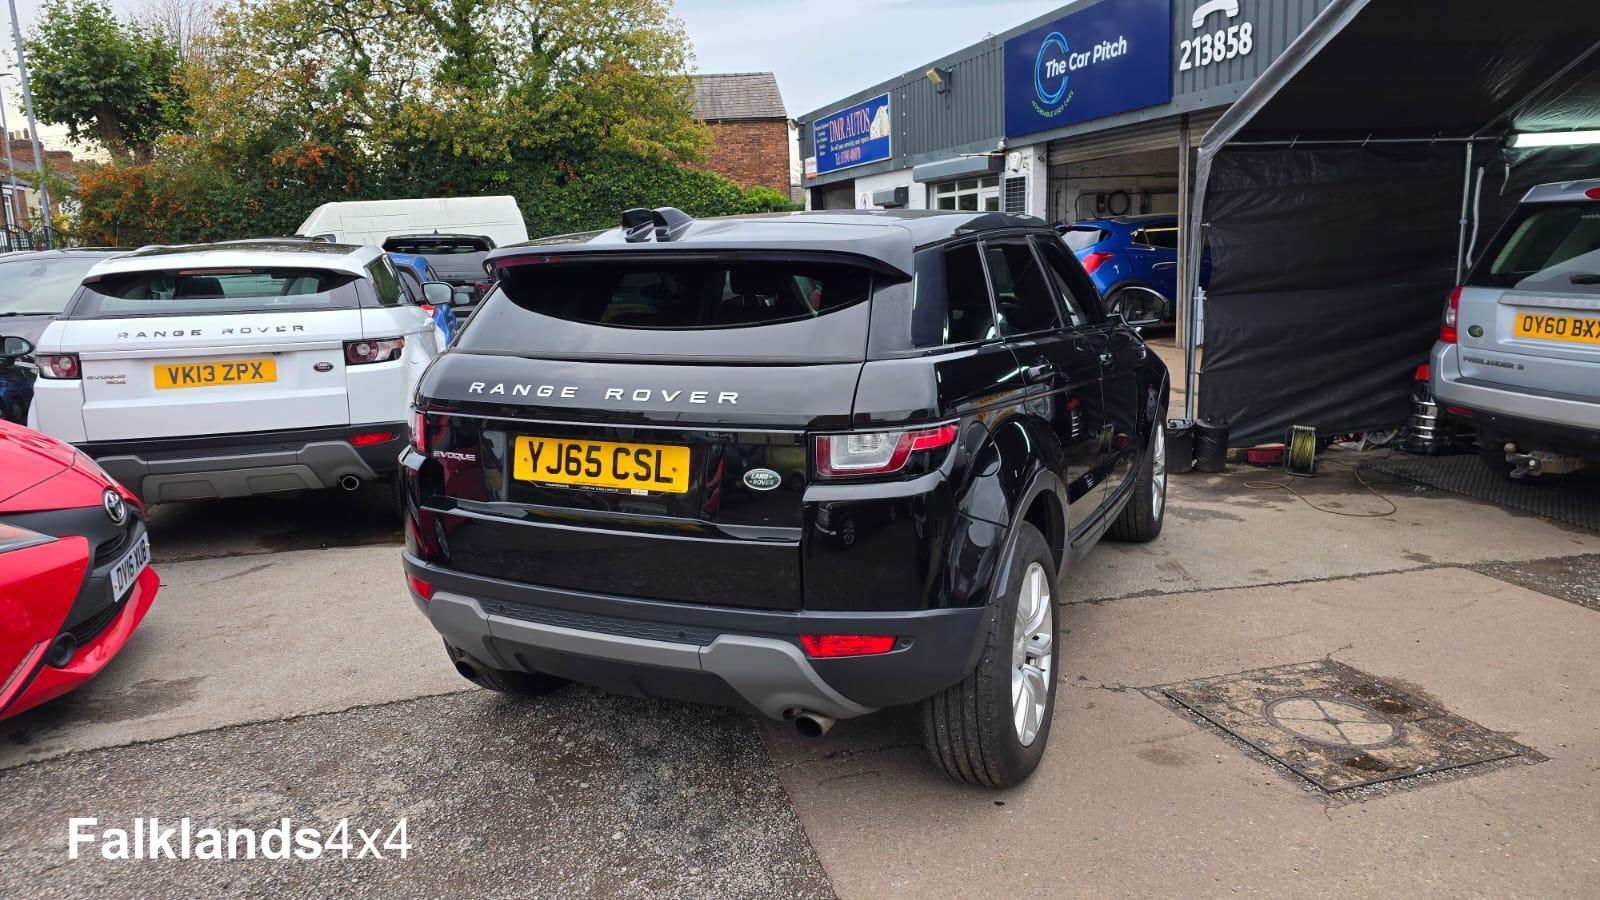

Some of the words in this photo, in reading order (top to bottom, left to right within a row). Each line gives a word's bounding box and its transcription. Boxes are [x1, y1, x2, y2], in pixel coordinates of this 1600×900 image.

[1045, 58, 1067, 79] The
[1068, 51, 1091, 71] Car
[1092, 35, 1128, 64] Pitch
[1179, 21, 1253, 71] 213858
[829, 117, 846, 143] DMR
[846, 107, 871, 138] AUTOS
[116, 329, 204, 340] RANGE
[221, 324, 306, 335] ROVER
[1522, 315, 1567, 336] OY60
[167, 365, 216, 385] VK13
[221, 362, 264, 382] ZPX
[468, 381, 579, 399] RANGE
[604, 388, 740, 405] ROVER
[433, 450, 477, 462] EVOQUE
[528, 440, 602, 479] YJ65
[612, 447, 674, 485] CSL
